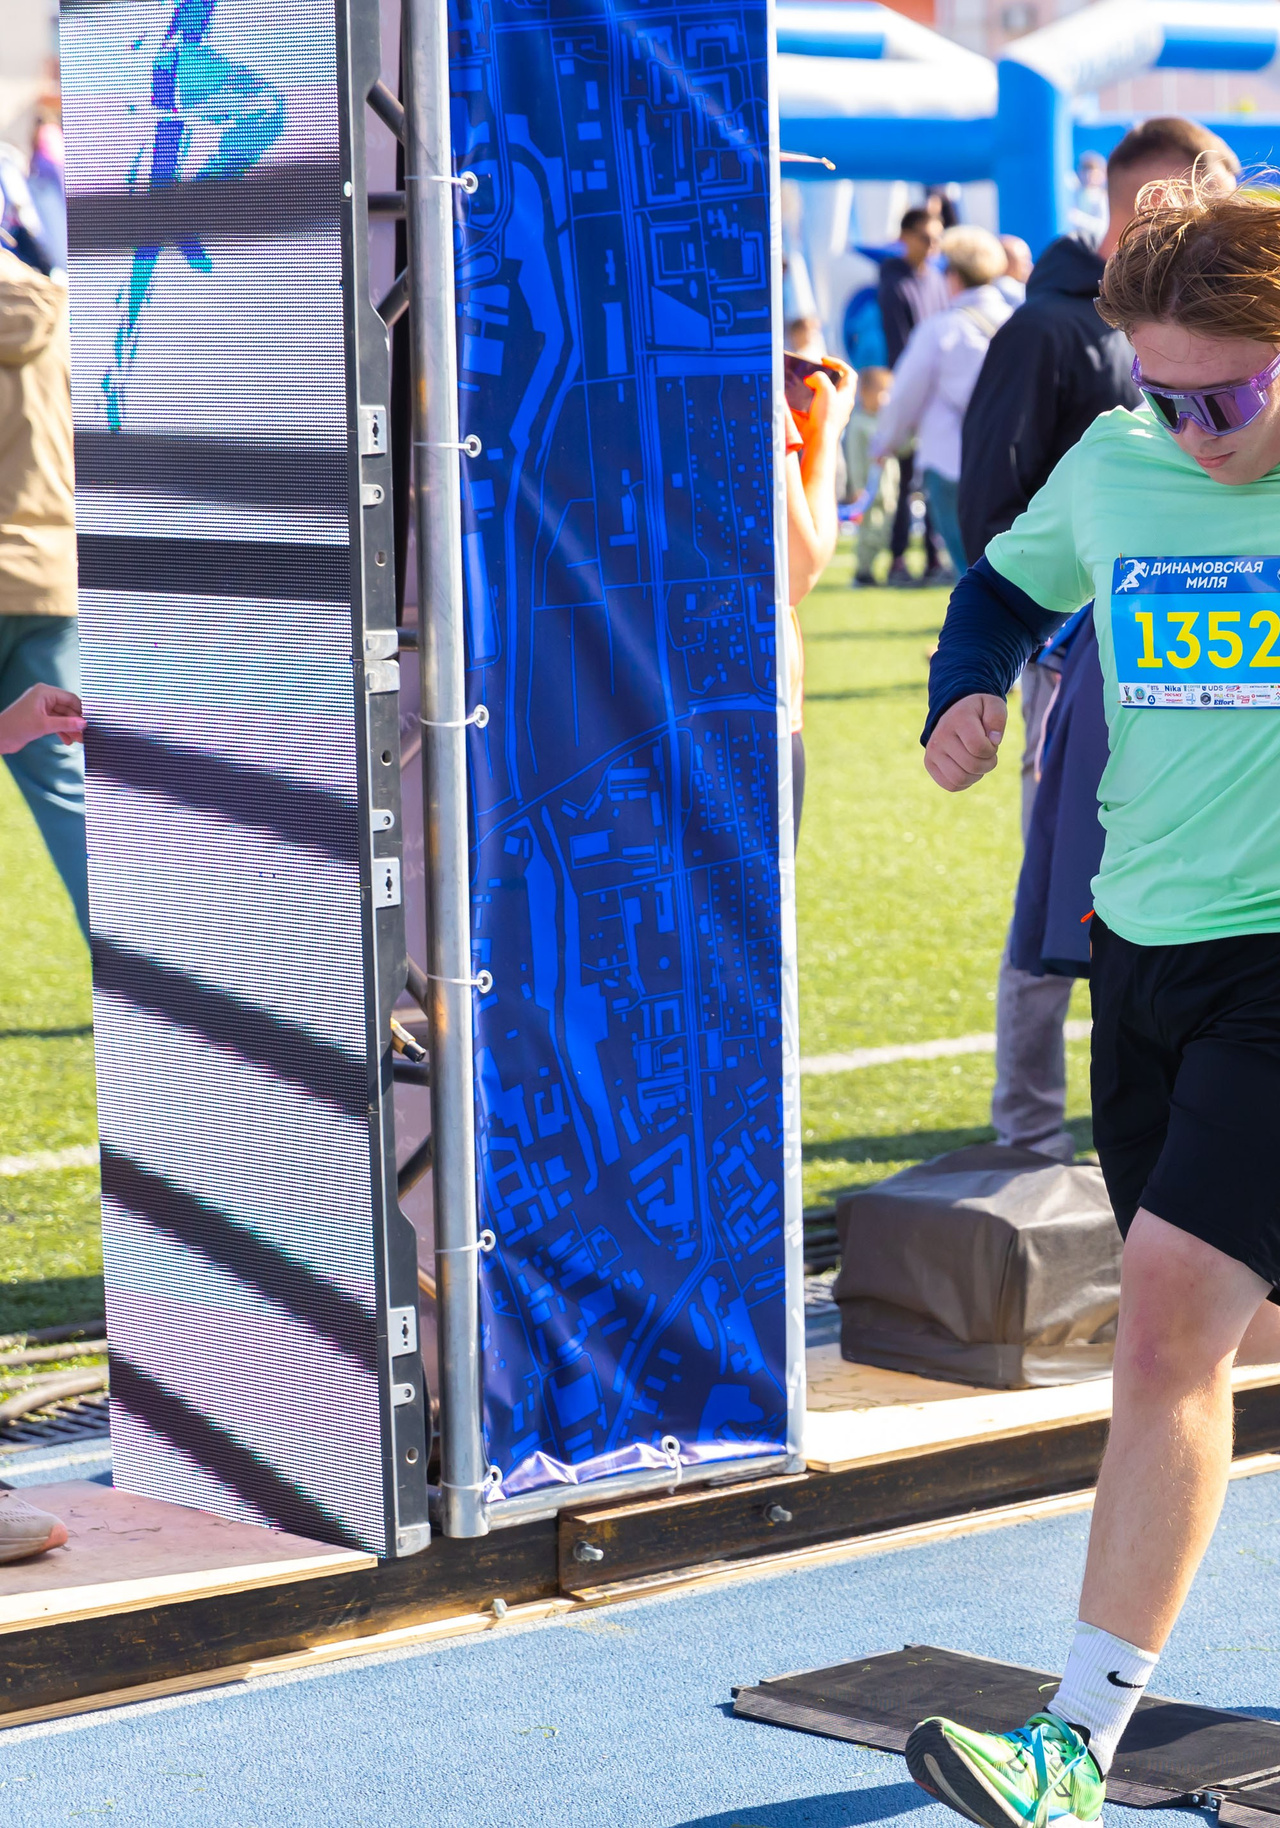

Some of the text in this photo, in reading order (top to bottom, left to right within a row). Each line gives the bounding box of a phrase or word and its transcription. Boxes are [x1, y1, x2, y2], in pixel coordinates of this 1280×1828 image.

[1150, 561, 1264, 576] ДИНАМОВСКАЯ
[1185, 576, 1229, 589] МИЛЯ
[1164, 684, 1182, 692] Nika
